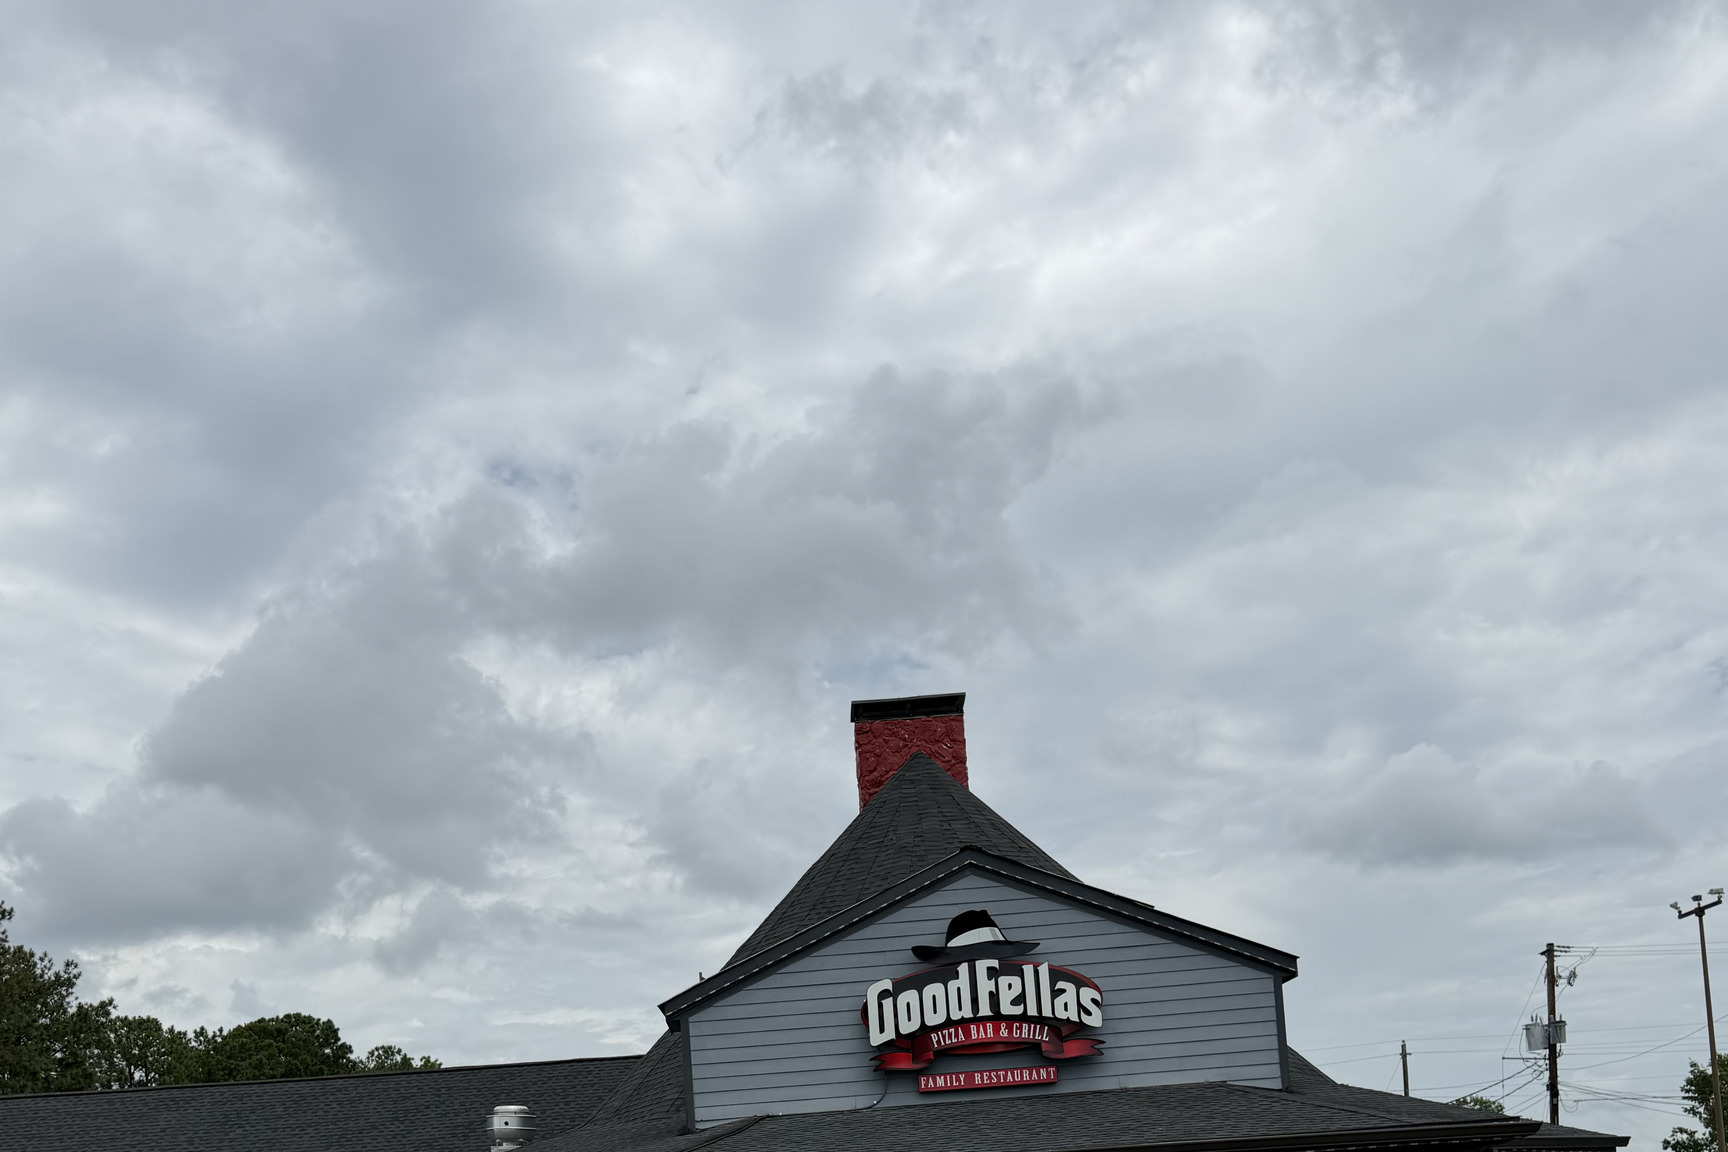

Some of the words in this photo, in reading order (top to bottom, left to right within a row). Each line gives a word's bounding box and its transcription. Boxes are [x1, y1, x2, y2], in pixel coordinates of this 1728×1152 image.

[866, 959, 1103, 1047] GoodFellas
[930, 1024, 965, 1048] PIZZA
[970, 1022, 994, 1039] BAR
[999, 1023, 1009, 1037] &
[1013, 1022, 1049, 1042] GRILL
[920, 1074, 966, 1089] FAMILY
[974, 1067, 1056, 1085] RESTAURANT
